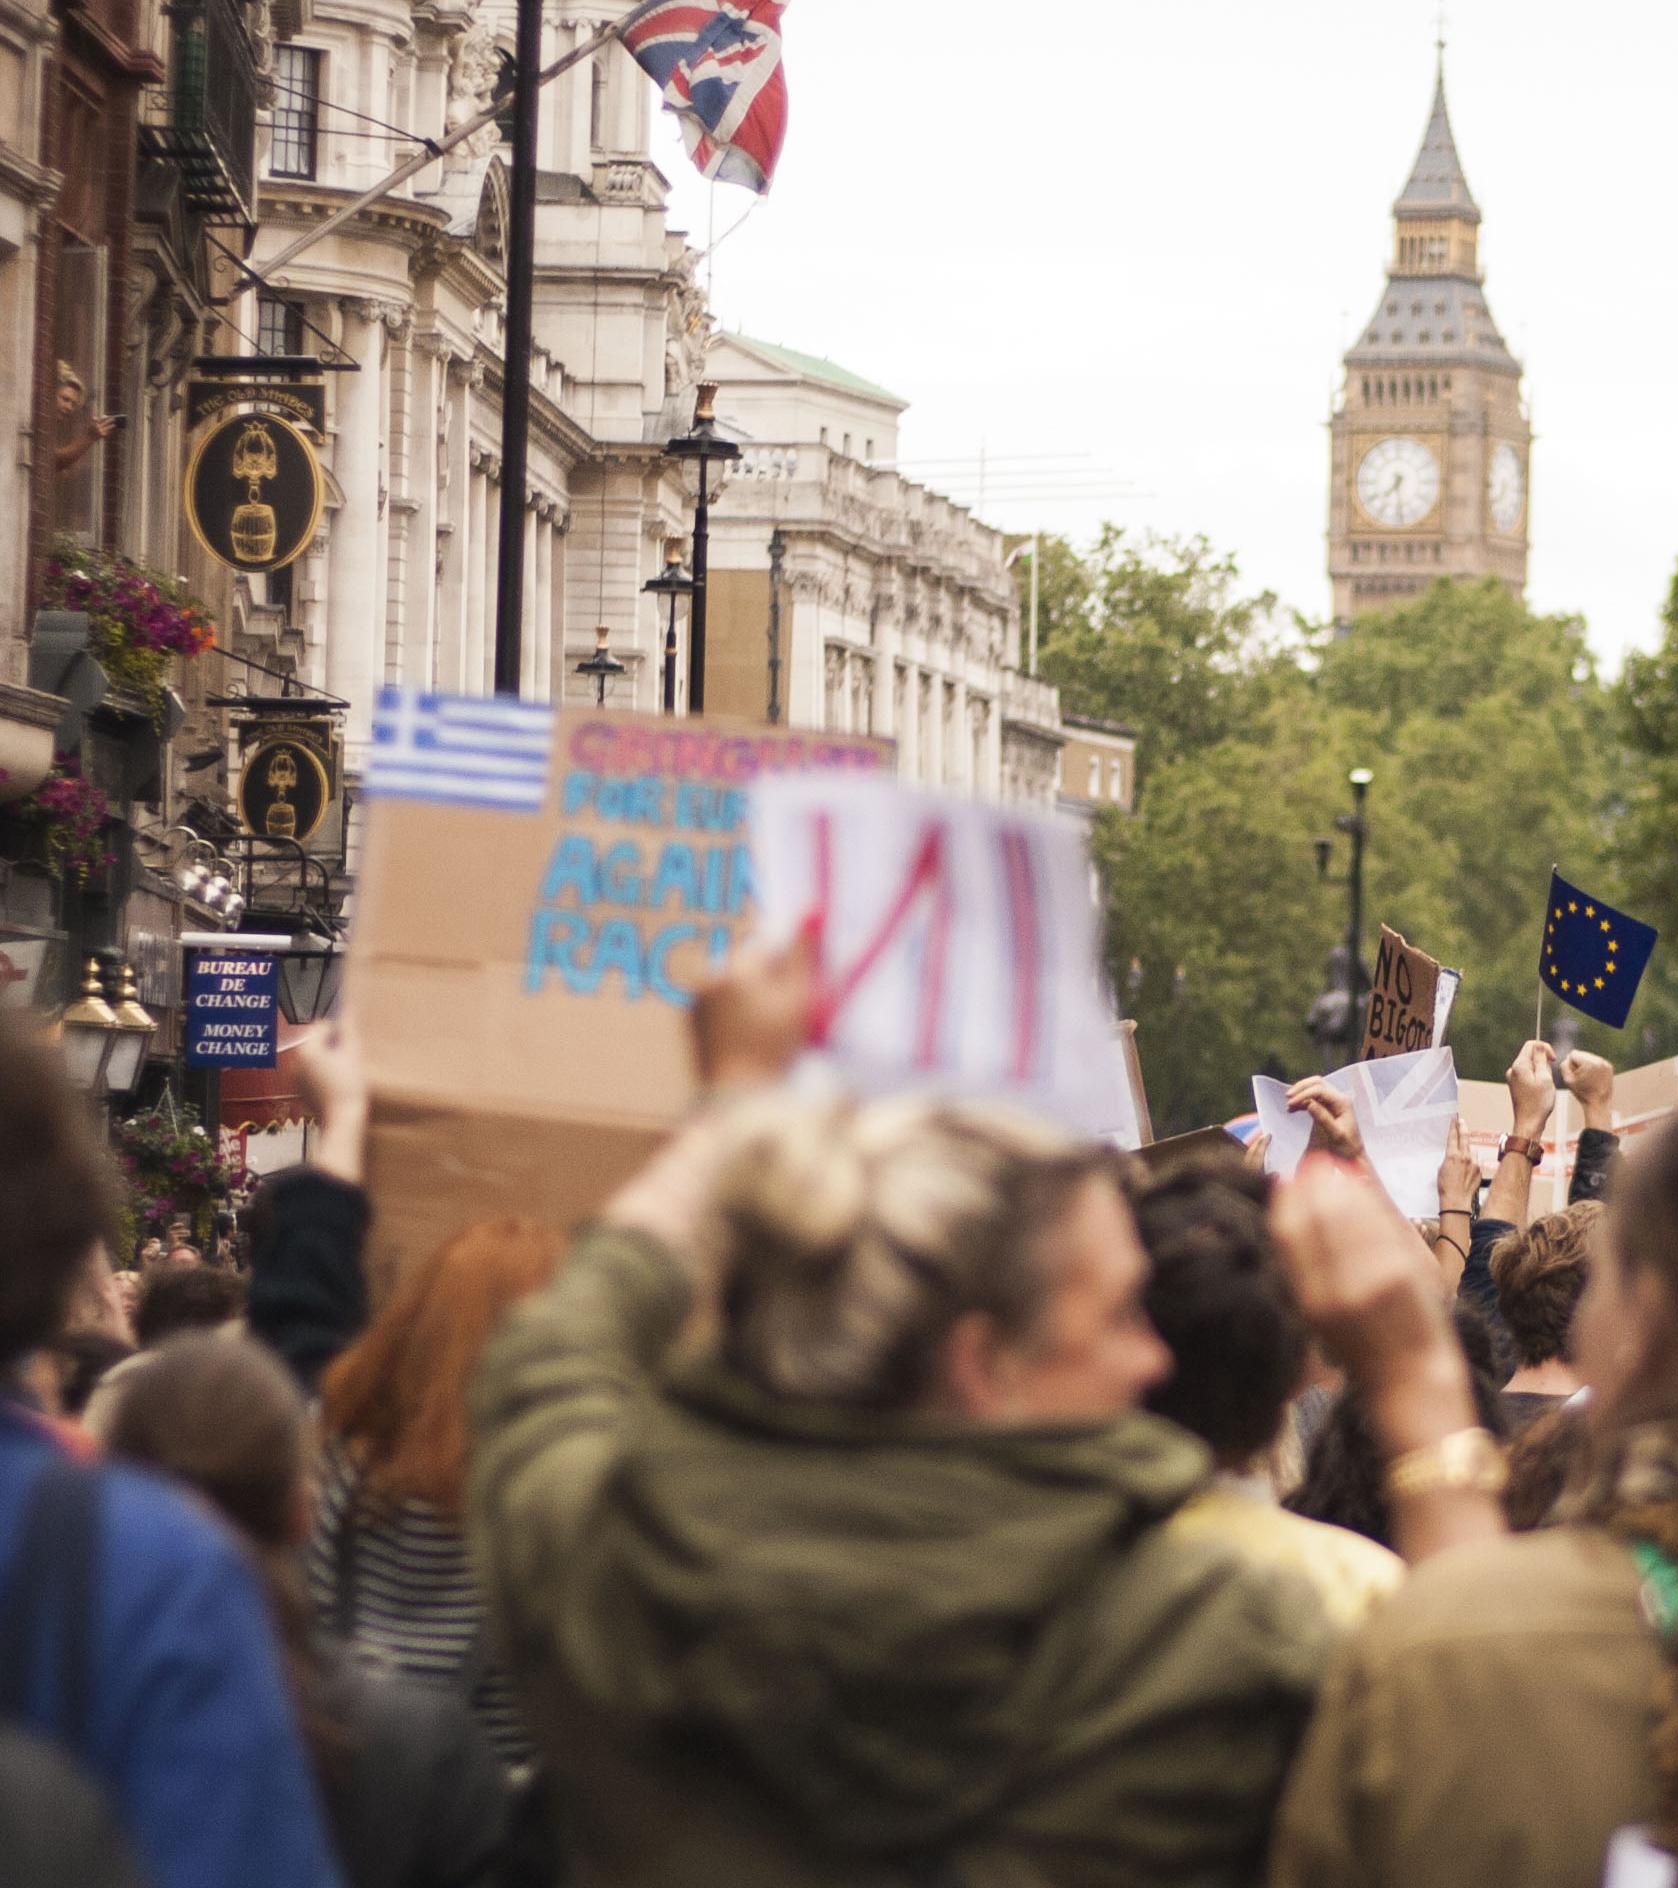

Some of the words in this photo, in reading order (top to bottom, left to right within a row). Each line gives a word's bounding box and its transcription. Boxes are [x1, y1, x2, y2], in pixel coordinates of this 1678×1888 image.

[563, 772, 663, 826] FOR
[197, 961, 272, 976] BUREAU
[1374, 937, 1412, 1005] NO
[219, 978, 246, 992] DE
[195, 994, 271, 1009] CHANGE
[203, 1024, 268, 1038] MONEY
[195, 1041, 270, 1056] CHANGE
